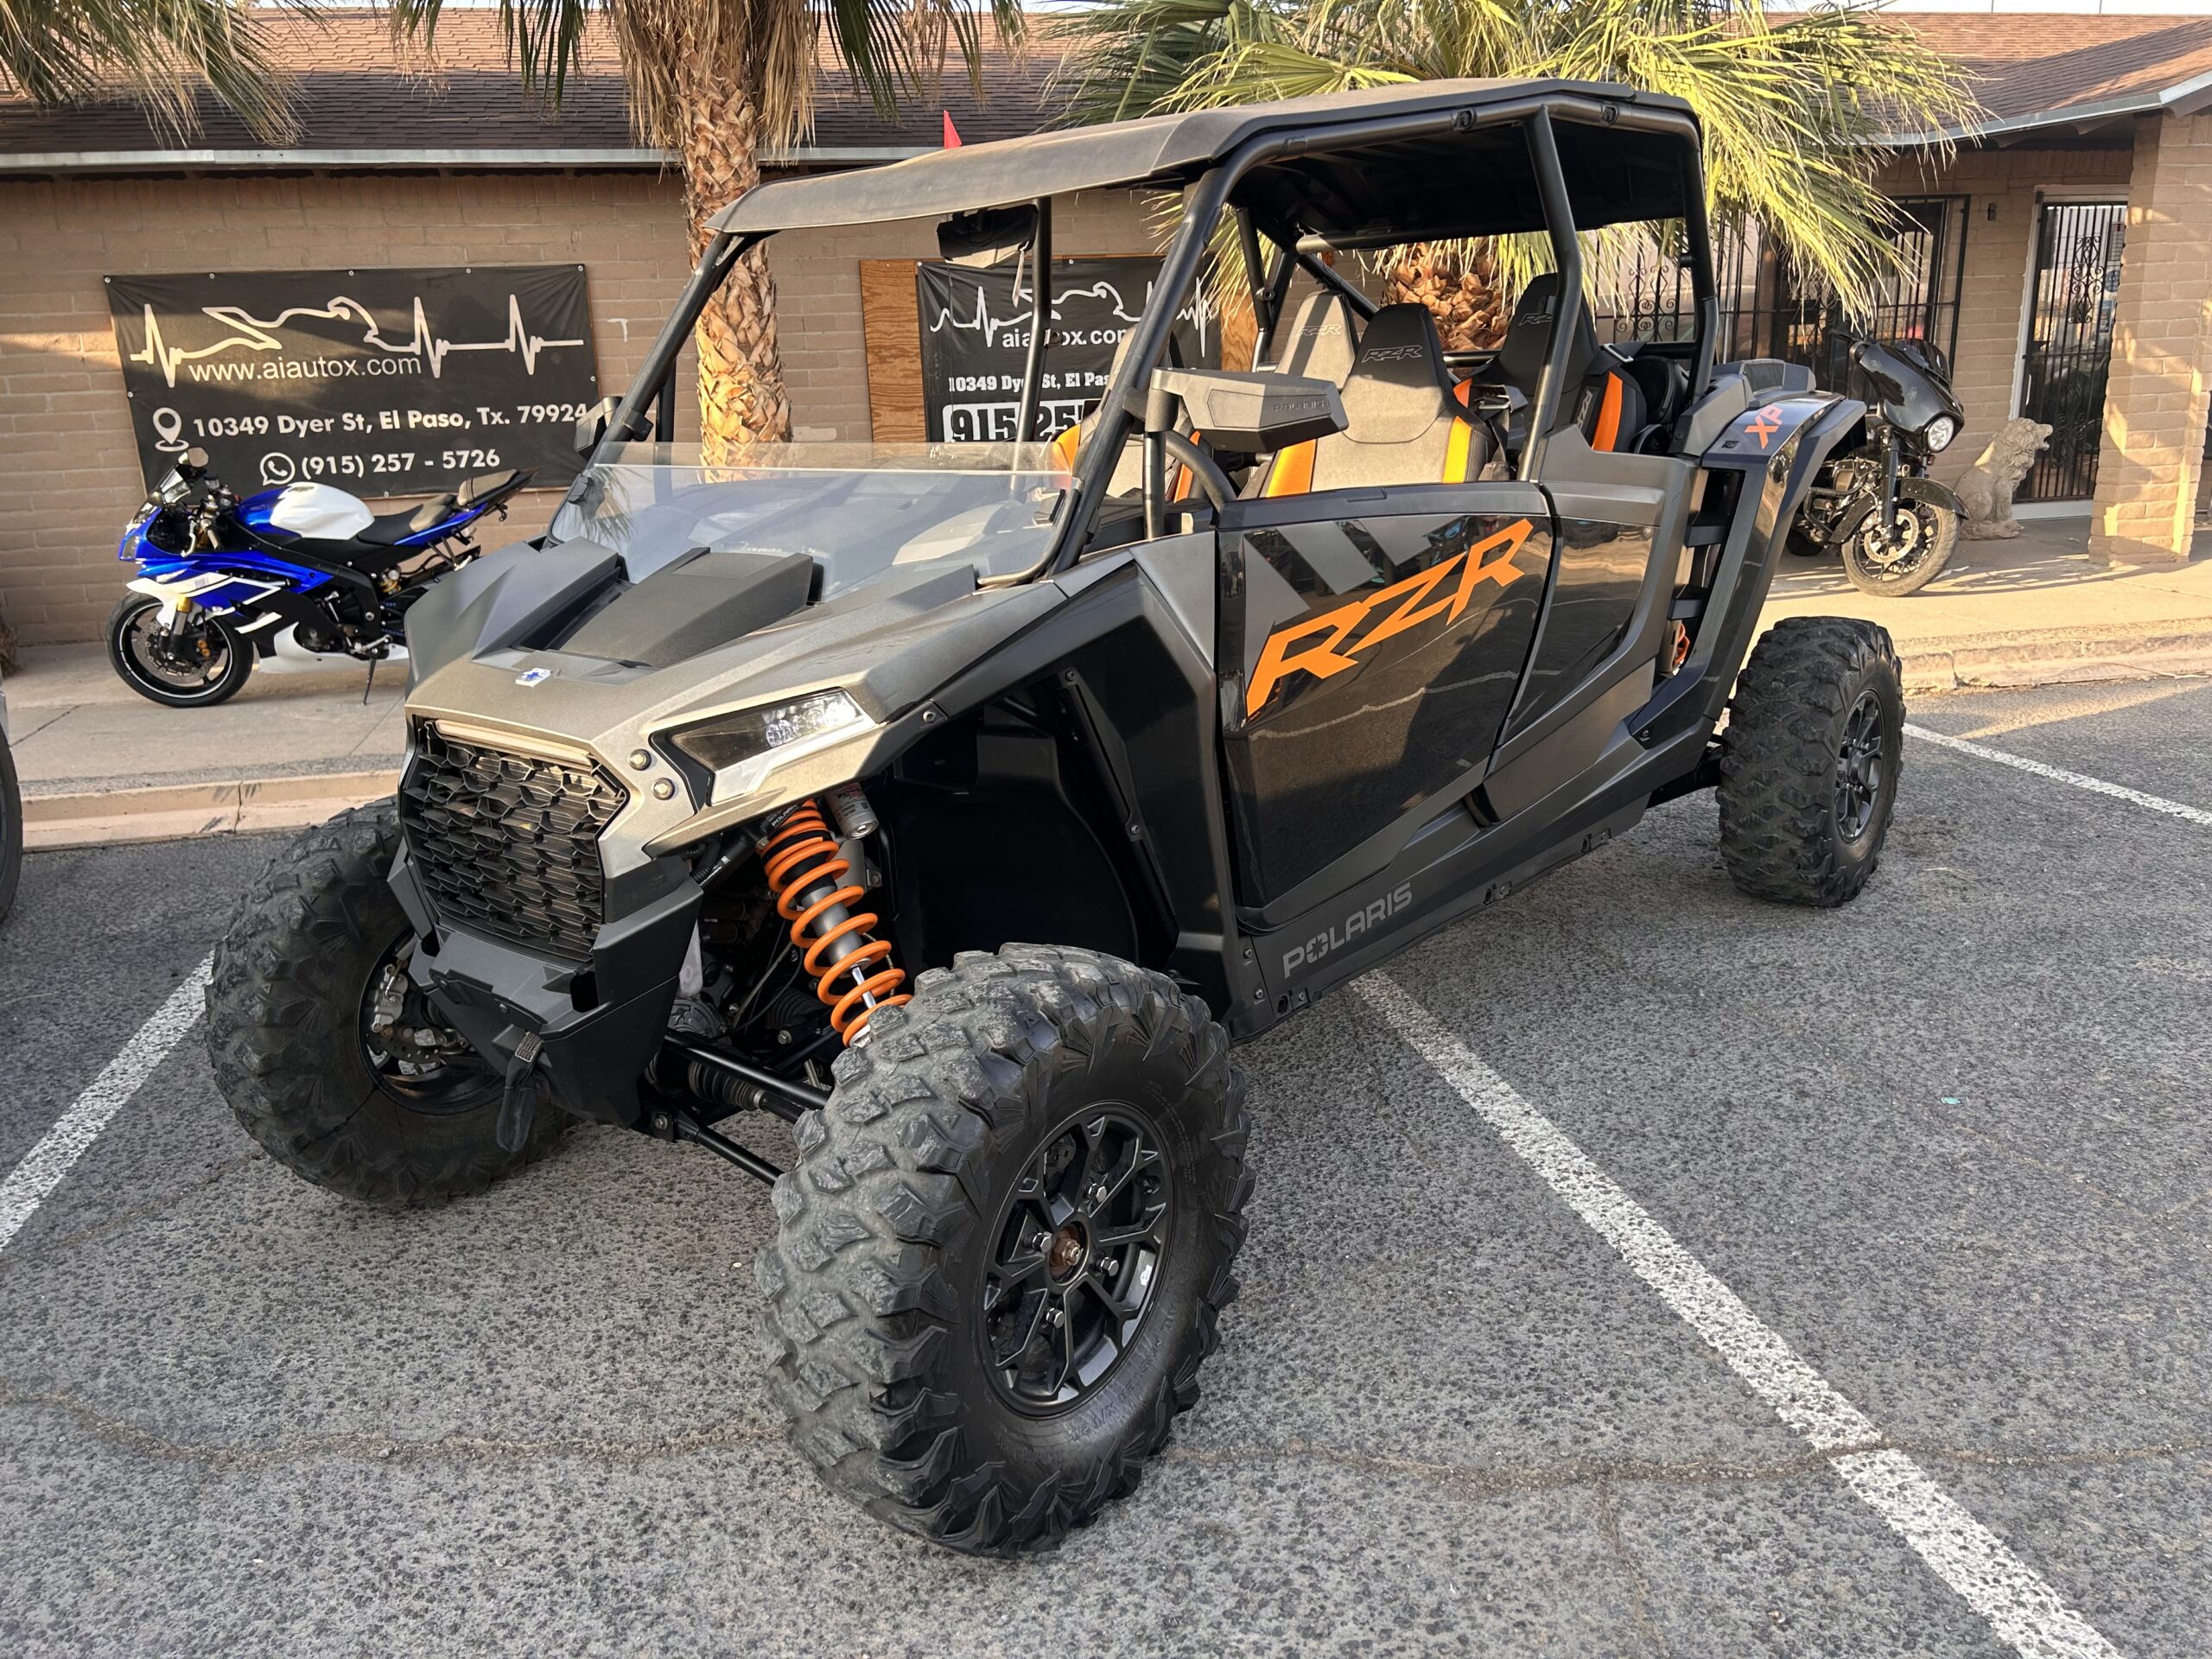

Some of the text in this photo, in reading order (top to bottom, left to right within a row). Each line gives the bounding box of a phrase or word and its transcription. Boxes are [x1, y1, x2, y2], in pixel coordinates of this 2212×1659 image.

[1298, 324, 1342, 338] RZR
[1519, 313, 1553, 326] RZ
[1002, 328, 1128, 347] aiaox.co
[1362, 345, 1423, 363] RZR
[188, 357, 422, 383] www.aiautox.com
[949, 372, 1109, 393] 10349 Dy St, El Pas
[1273, 400, 1326, 413] POLARIS
[193, 403, 588, 438] 10349 Dyer St, El Paso, Tx. 79924
[1037, 405, 1084, 442] 25
[1745, 404, 1784, 450] XP
[301, 454, 365, 480] (915)
[372, 453, 415, 474] 257
[442, 448, 500, 469] 5726
[1245, 518, 1535, 717] RZR
[1282, 881, 1413, 979] POLARIS
